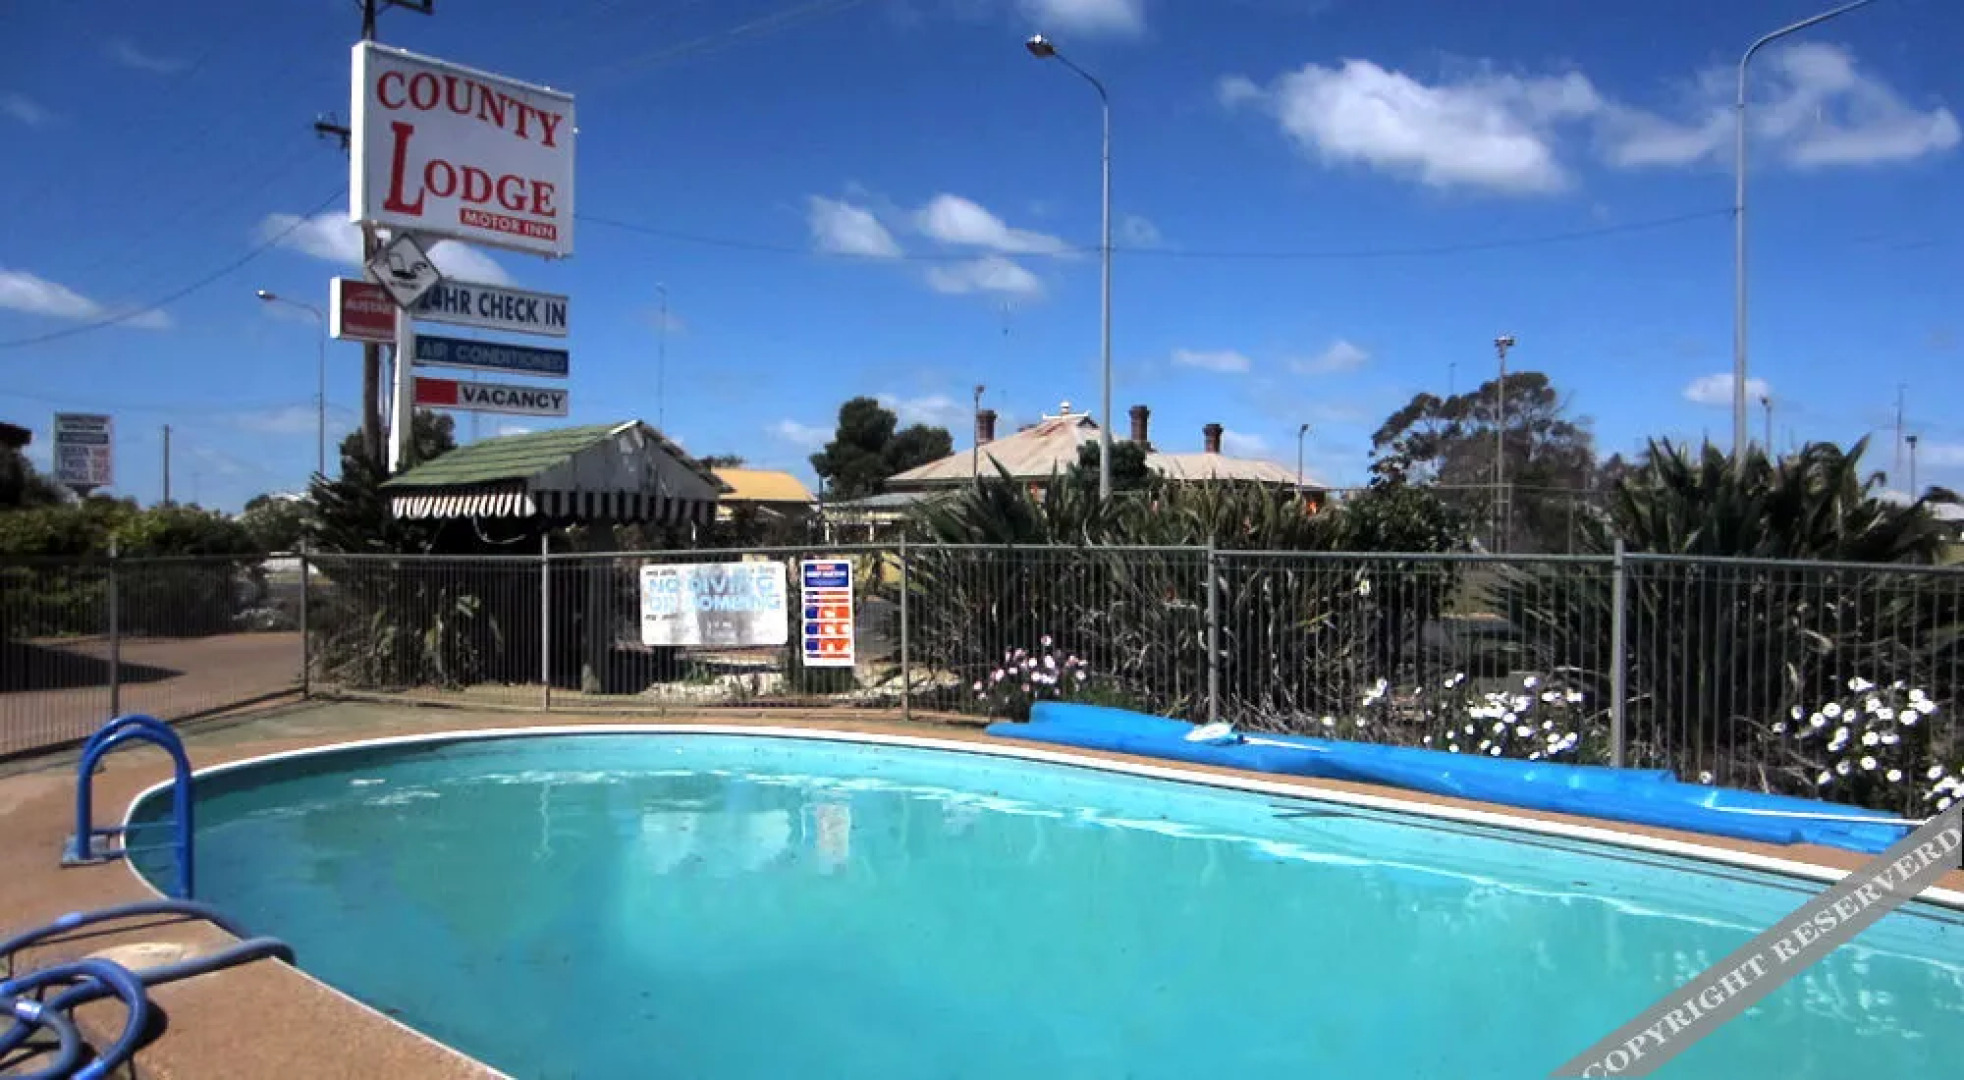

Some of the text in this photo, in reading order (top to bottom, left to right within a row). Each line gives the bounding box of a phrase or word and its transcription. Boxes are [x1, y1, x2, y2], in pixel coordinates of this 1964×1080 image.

[377, 70, 562, 147] COUNTY
[464, 209, 554, 239] MOTOR INN
[478, 291, 539, 325] CHECK
[545, 299, 567, 329] IN
[421, 342, 565, 370] AIR CONDITIONED
[462, 386, 562, 409] VACANCY
[649, 577, 679, 594] NO
